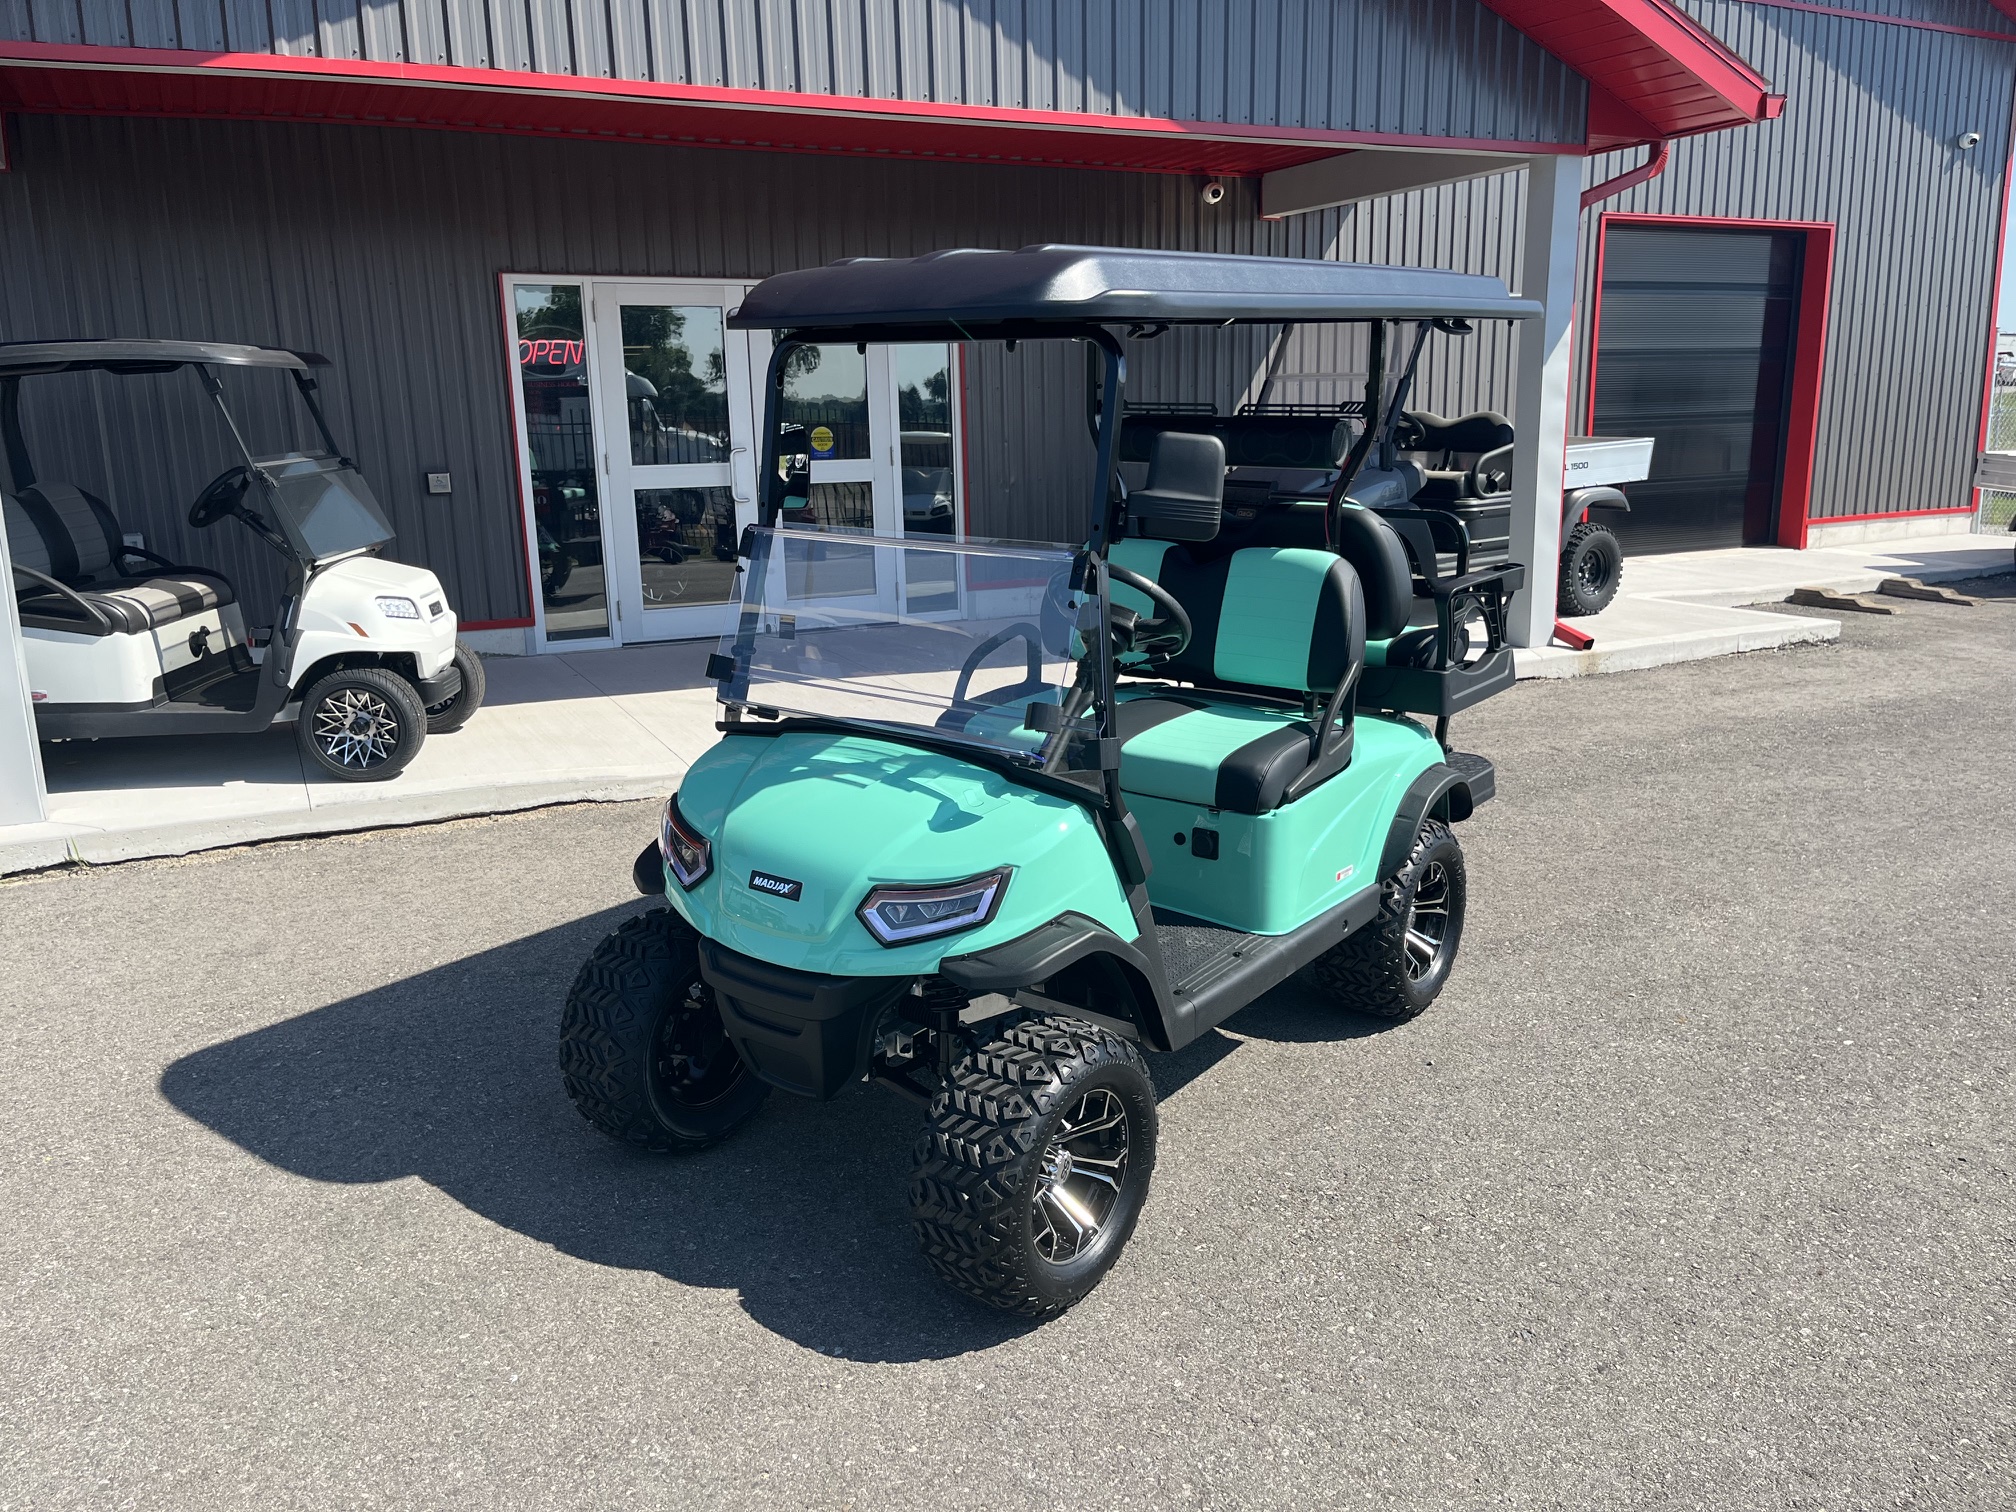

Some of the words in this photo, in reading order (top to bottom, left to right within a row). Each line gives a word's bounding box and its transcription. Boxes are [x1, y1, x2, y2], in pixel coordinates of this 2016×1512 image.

[519, 339, 584, 364] OPEN
[1570, 461, 1589, 470] 1500
[752, 876, 794, 894] MADJAX
